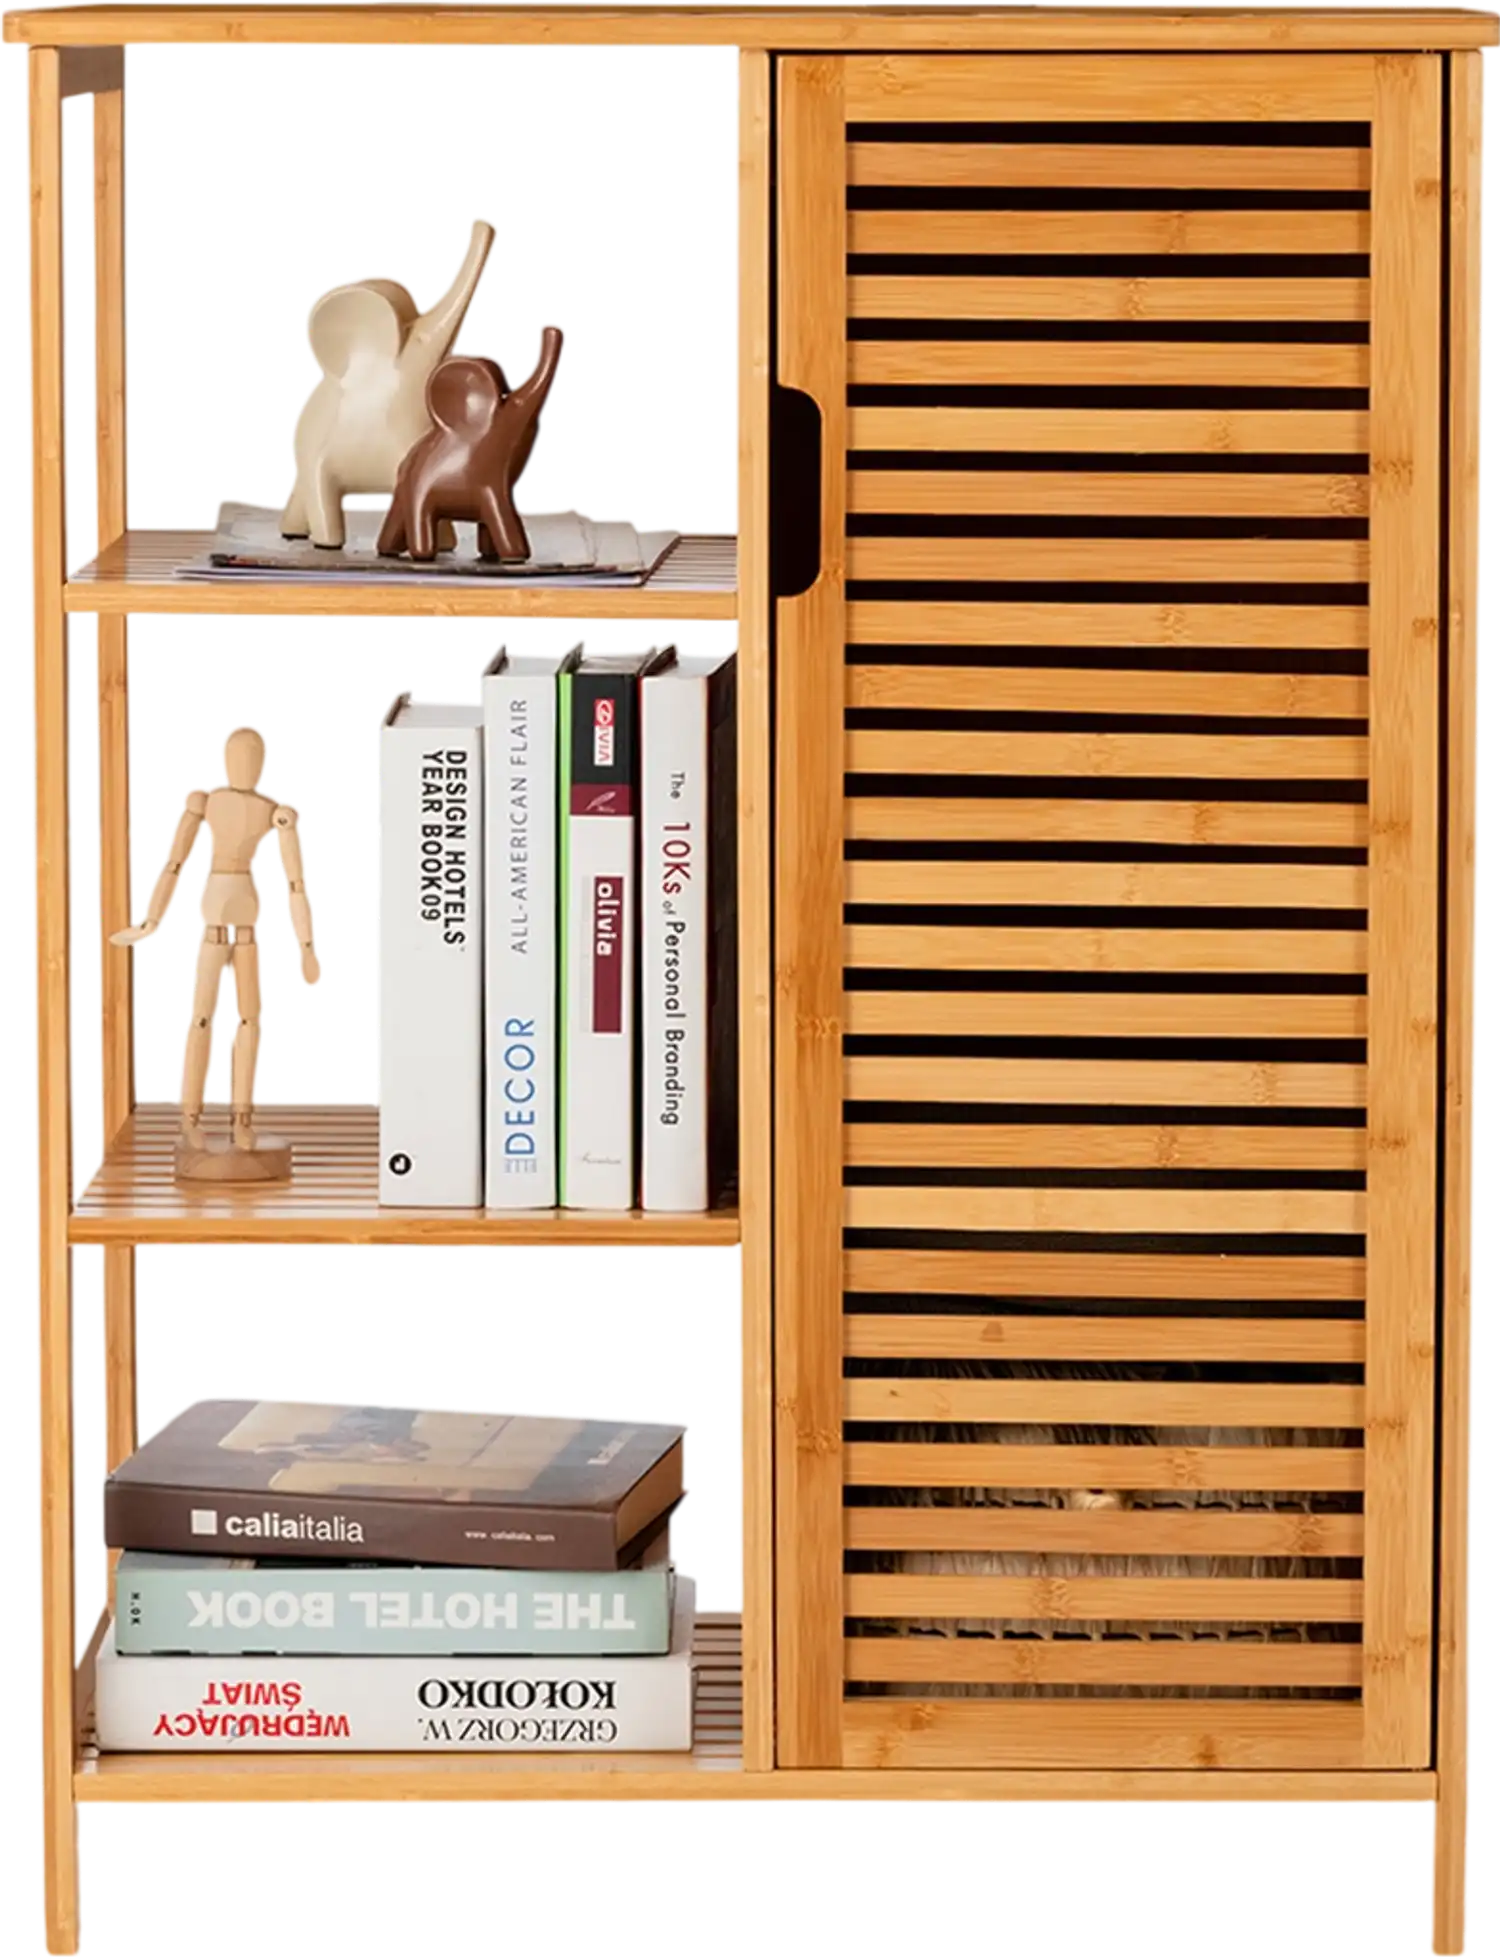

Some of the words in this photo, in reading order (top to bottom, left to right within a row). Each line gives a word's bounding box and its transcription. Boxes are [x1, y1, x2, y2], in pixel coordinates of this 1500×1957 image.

[510, 700, 528, 766] FLAIR
[421, 750, 443, 813] YEAR
[445, 750, 467, 840] DESIGN
[670, 773, 685, 799] The
[510, 777, 528, 954] ALL-AMERICAN
[444, 850, 466, 945] HOTELS
[662, 901, 676, 916] of
[597, 882, 621, 956] olivia
[664, 921, 686, 1018] Personal
[504, 1018, 535, 1155] DECOR
[660, 1029, 686, 1125] Branding
[225, 1513, 364, 1543] caliaitalia
[186, 1591, 335, 1629] BOOK
[348, 1592, 518, 1630] HOTEL
[531, 1592, 636, 1630] THE
[202, 1682, 303, 1711] ŚWIAT
[418, 1679, 616, 1710] KOŁODKO
[153, 1708, 351, 1738] WĘDRUJĄCY
[418, 1718, 452, 1742] W.
[458, 1718, 618, 1742] GRZEGORZ
